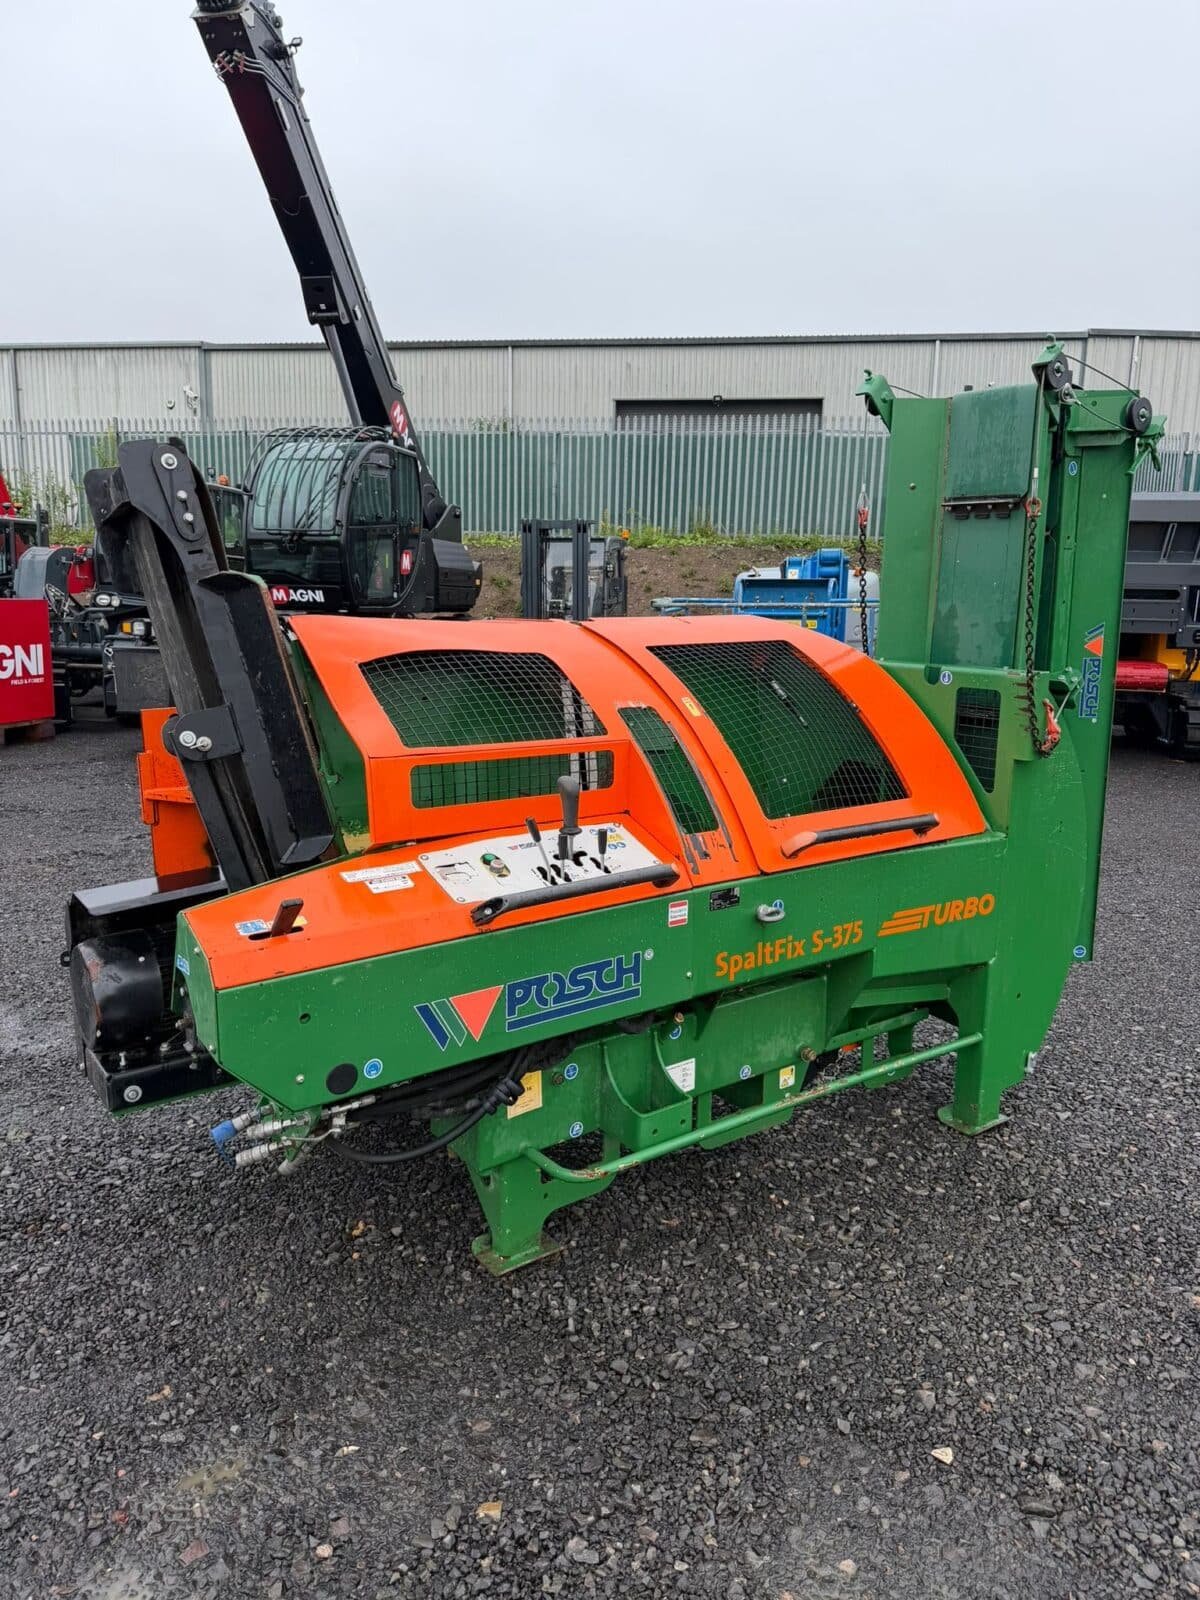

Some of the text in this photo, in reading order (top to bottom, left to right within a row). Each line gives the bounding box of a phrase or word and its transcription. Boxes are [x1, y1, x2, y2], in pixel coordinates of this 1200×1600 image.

[273, 587, 325, 602] MAGNI
[1084, 657, 1102, 718] POSCH
[894, 893, 995, 929] TURBO
[714, 919, 863, 981] SpaltFix S-375
[505, 950, 643, 1018] POSCH
